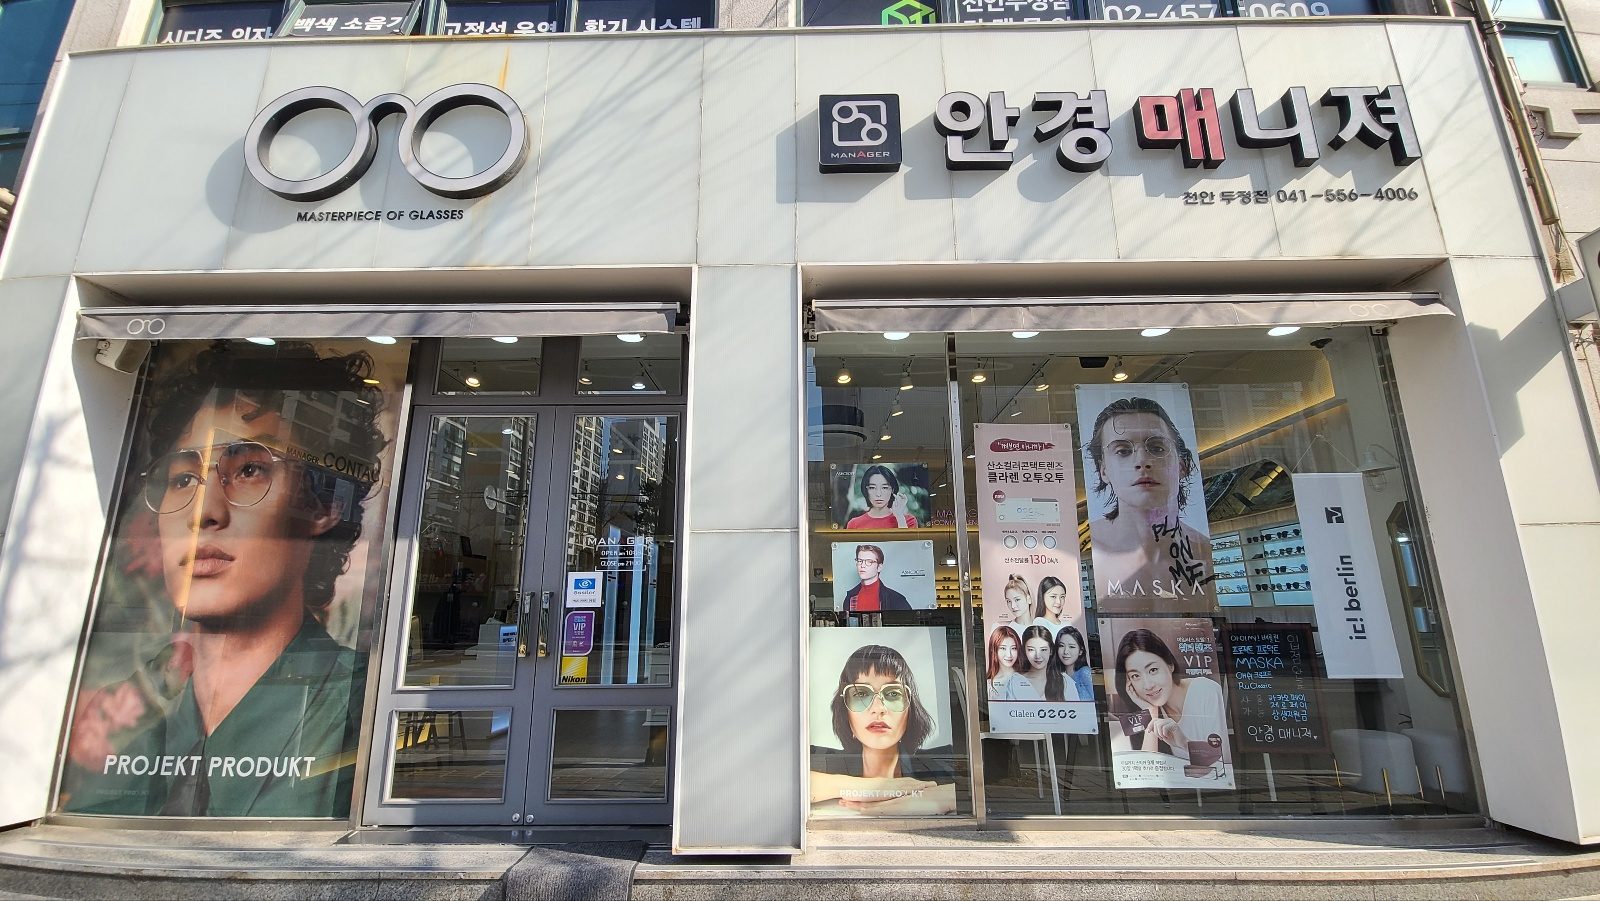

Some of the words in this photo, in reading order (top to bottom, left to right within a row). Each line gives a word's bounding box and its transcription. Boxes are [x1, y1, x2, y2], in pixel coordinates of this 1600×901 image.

[294, 16, 337, 32] 백색
[933, 89, 1114, 173] 안경
[1132, 85, 1423, 169] 매니져
[830, 150, 890, 159] MANAGER
[1182, 190, 1215, 206] 천안
[1219, 190, 1270, 205] 두정점
[1276, 187, 1419, 203] 041-556-4006
[296, 210, 382, 222] MASTERPIECE
[386, 209, 404, 221] OF
[408, 209, 464, 220] GLASSES
[987, 461, 1064, 471] 산소컬러콘택트렌즈
[988, 472, 1020, 484] 클라렌
[1022, 472, 1065, 484] 오투오투
[1170, 535, 1194, 565] ON
[1029, 554, 1047, 565] 130
[1107, 579, 1205, 596] MASKA
[1335, 555, 1361, 611] berlin
[573, 622, 587, 632] VIP
[1346, 617, 1367, 640] ic!
[1183, 655, 1212, 668] VIP
[1235, 656, 1285, 670] MASKA
[561, 675, 587, 684] Nikon
[1009, 710, 1035, 718] Clalen
[1128, 716, 1143, 725] VIP
[1247, 724, 1275, 743] 안경
[103, 754, 202, 776] PROJEKT
[208, 756, 316, 778] PRODUKT
[883, 789, 924, 798] PROKT
